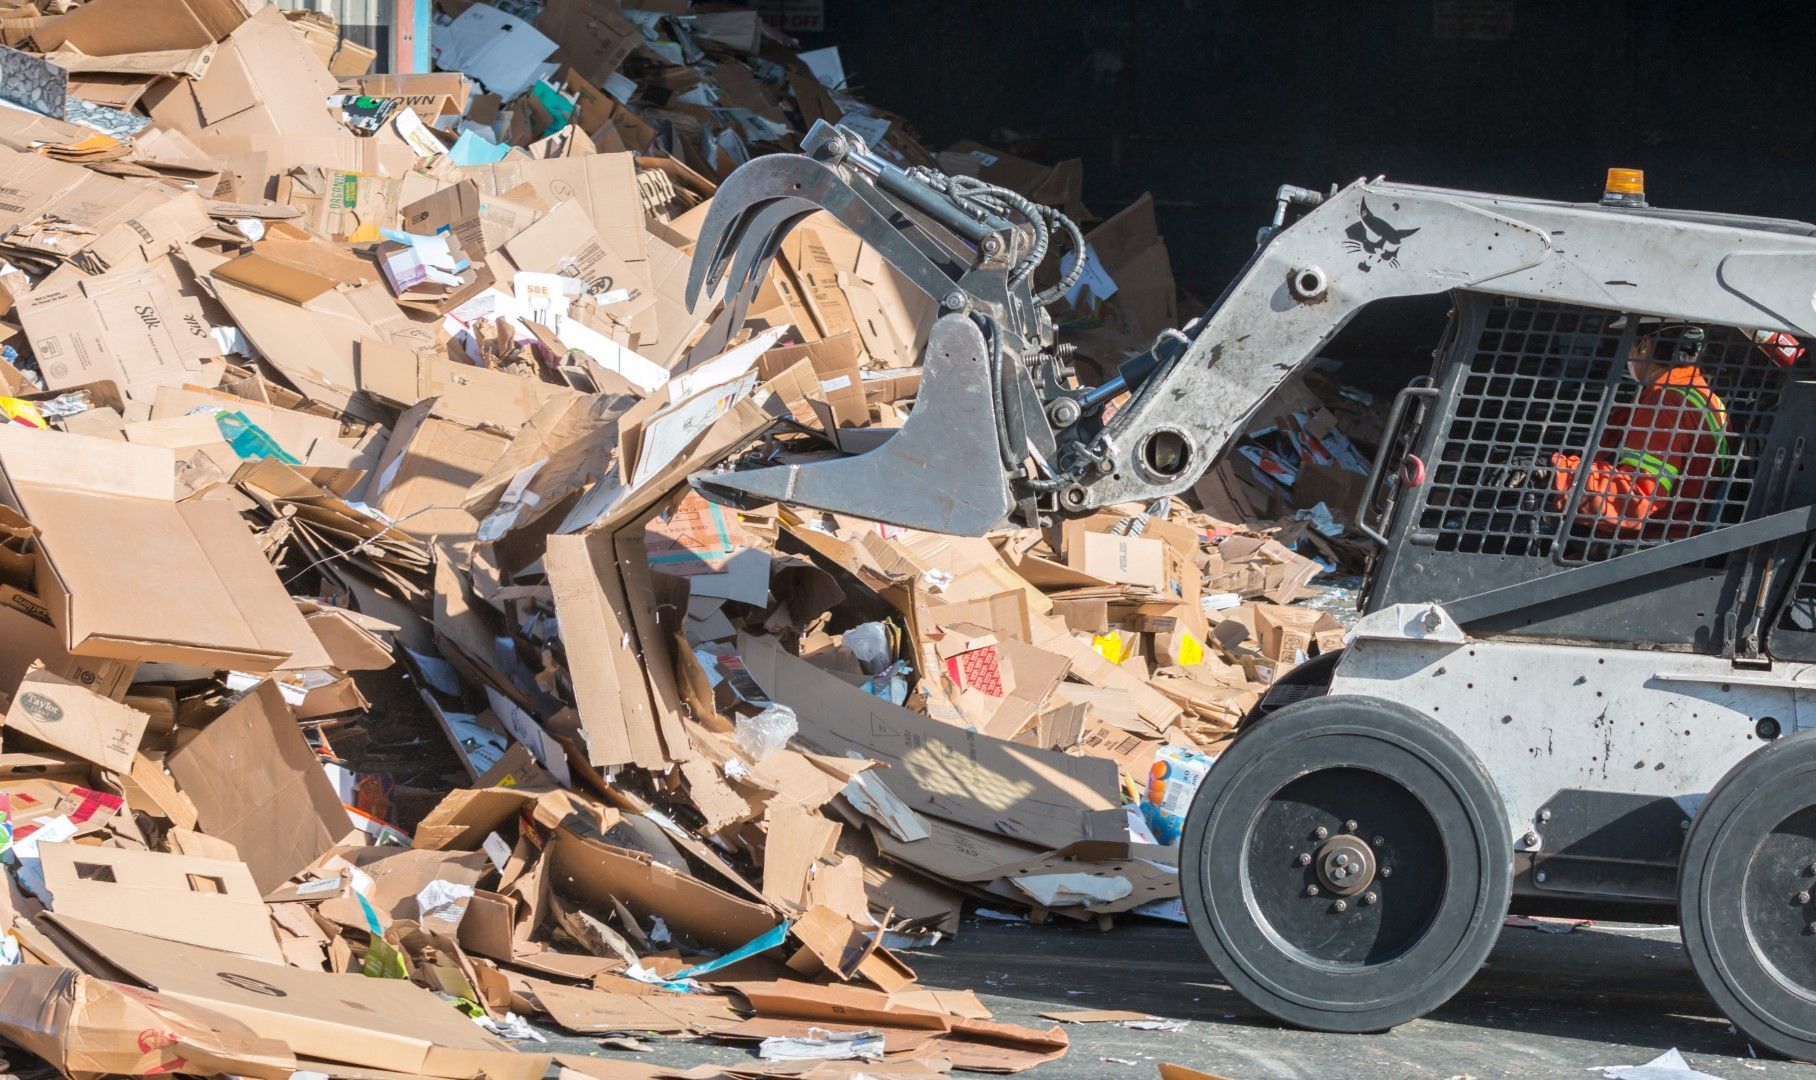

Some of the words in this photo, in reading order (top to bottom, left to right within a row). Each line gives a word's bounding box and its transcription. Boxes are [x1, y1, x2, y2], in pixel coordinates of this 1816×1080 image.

[388, 96, 436, 106] OWN
[330, 173, 345, 208] ORGANIC
[134, 305, 160, 330] Silk
[184, 313, 207, 338] Silk
[1119, 542, 1127, 573] ASUS
[27, 693, 59, 713] Taylor
